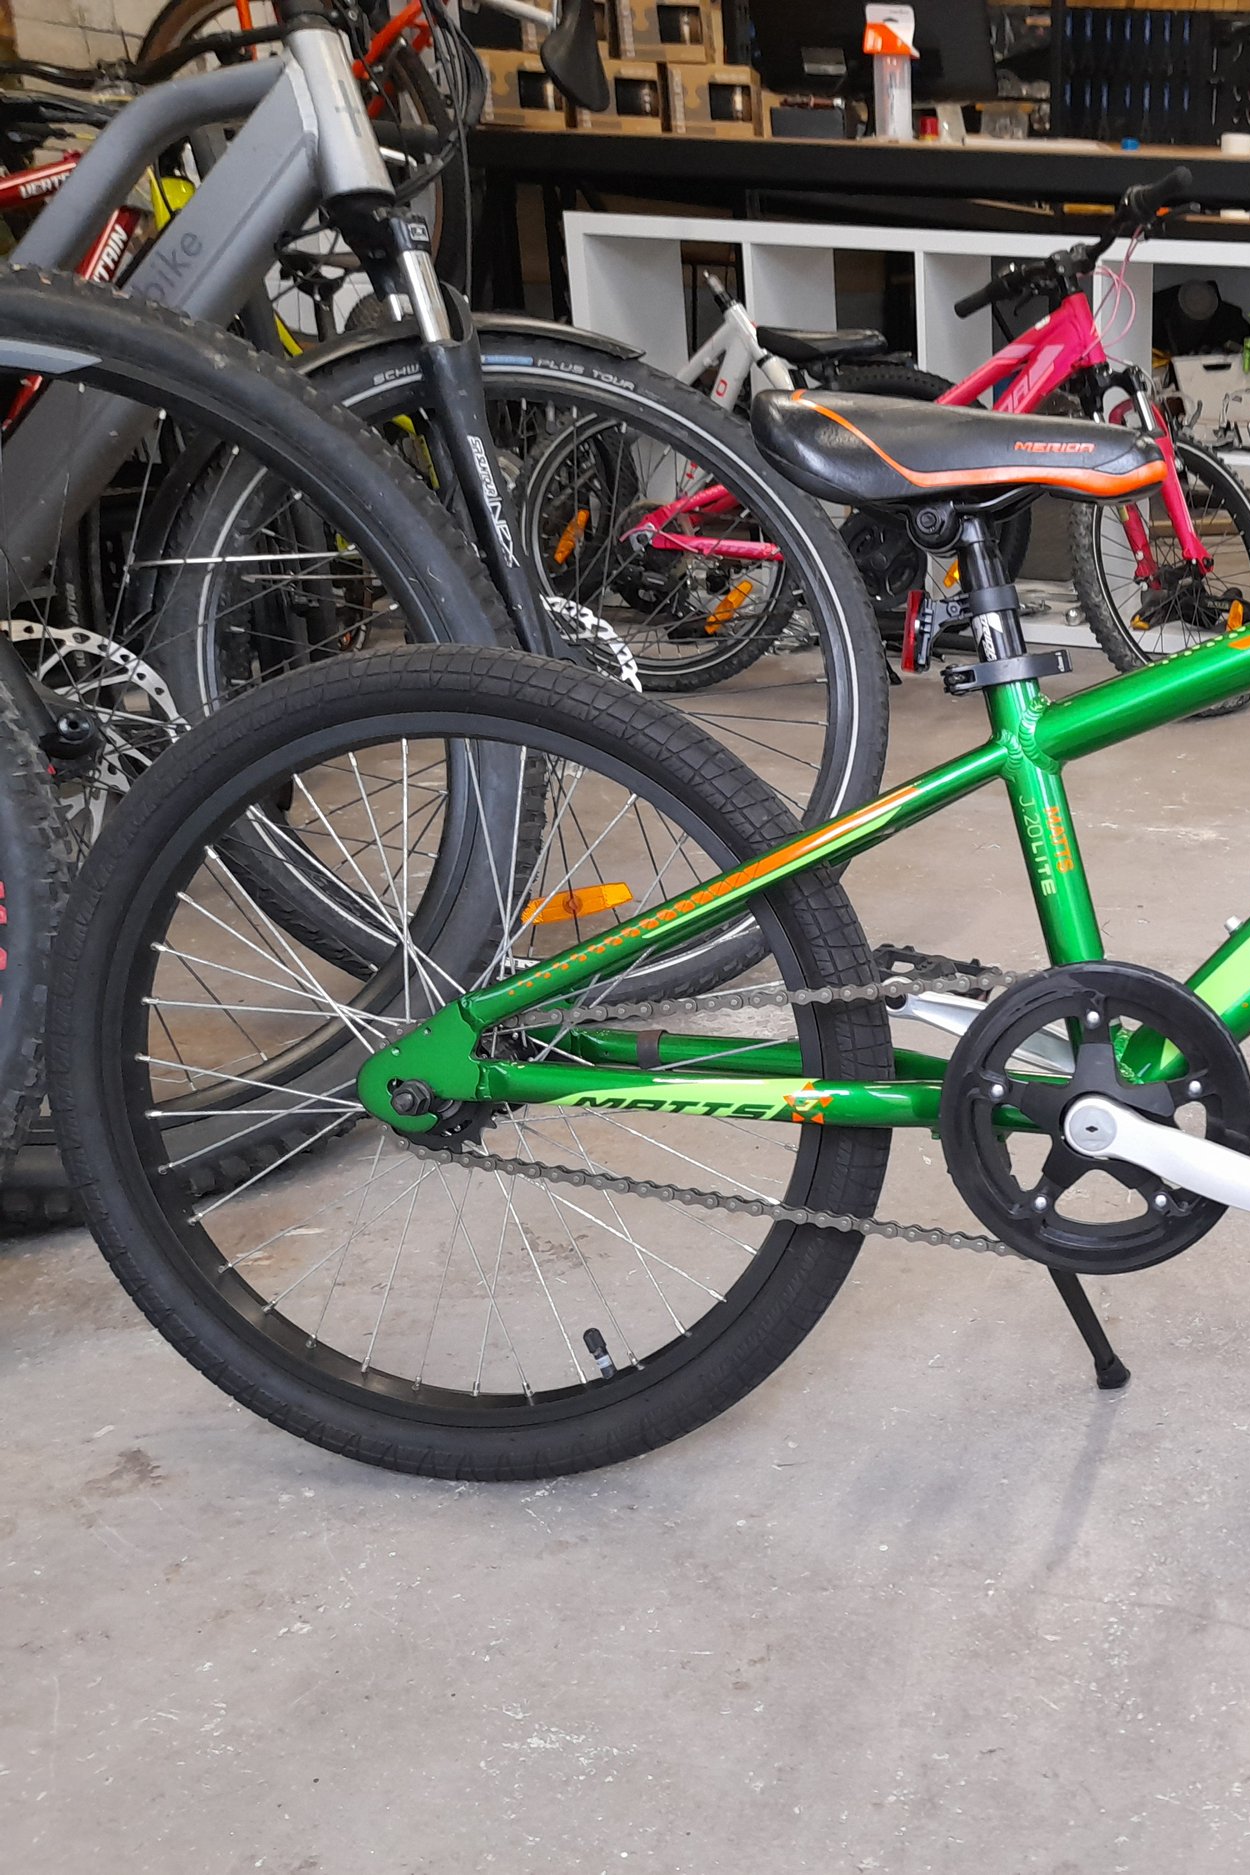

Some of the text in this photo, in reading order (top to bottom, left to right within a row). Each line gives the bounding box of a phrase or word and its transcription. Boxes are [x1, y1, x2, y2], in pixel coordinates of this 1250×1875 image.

[537, 358, 585, 375] PLUS
[592, 368, 635, 391] TOUR
[1013, 441, 1095, 453] MERIDA
[1043, 806, 1075, 873] MATTS
[571, 1096, 775, 1120] MATTS
